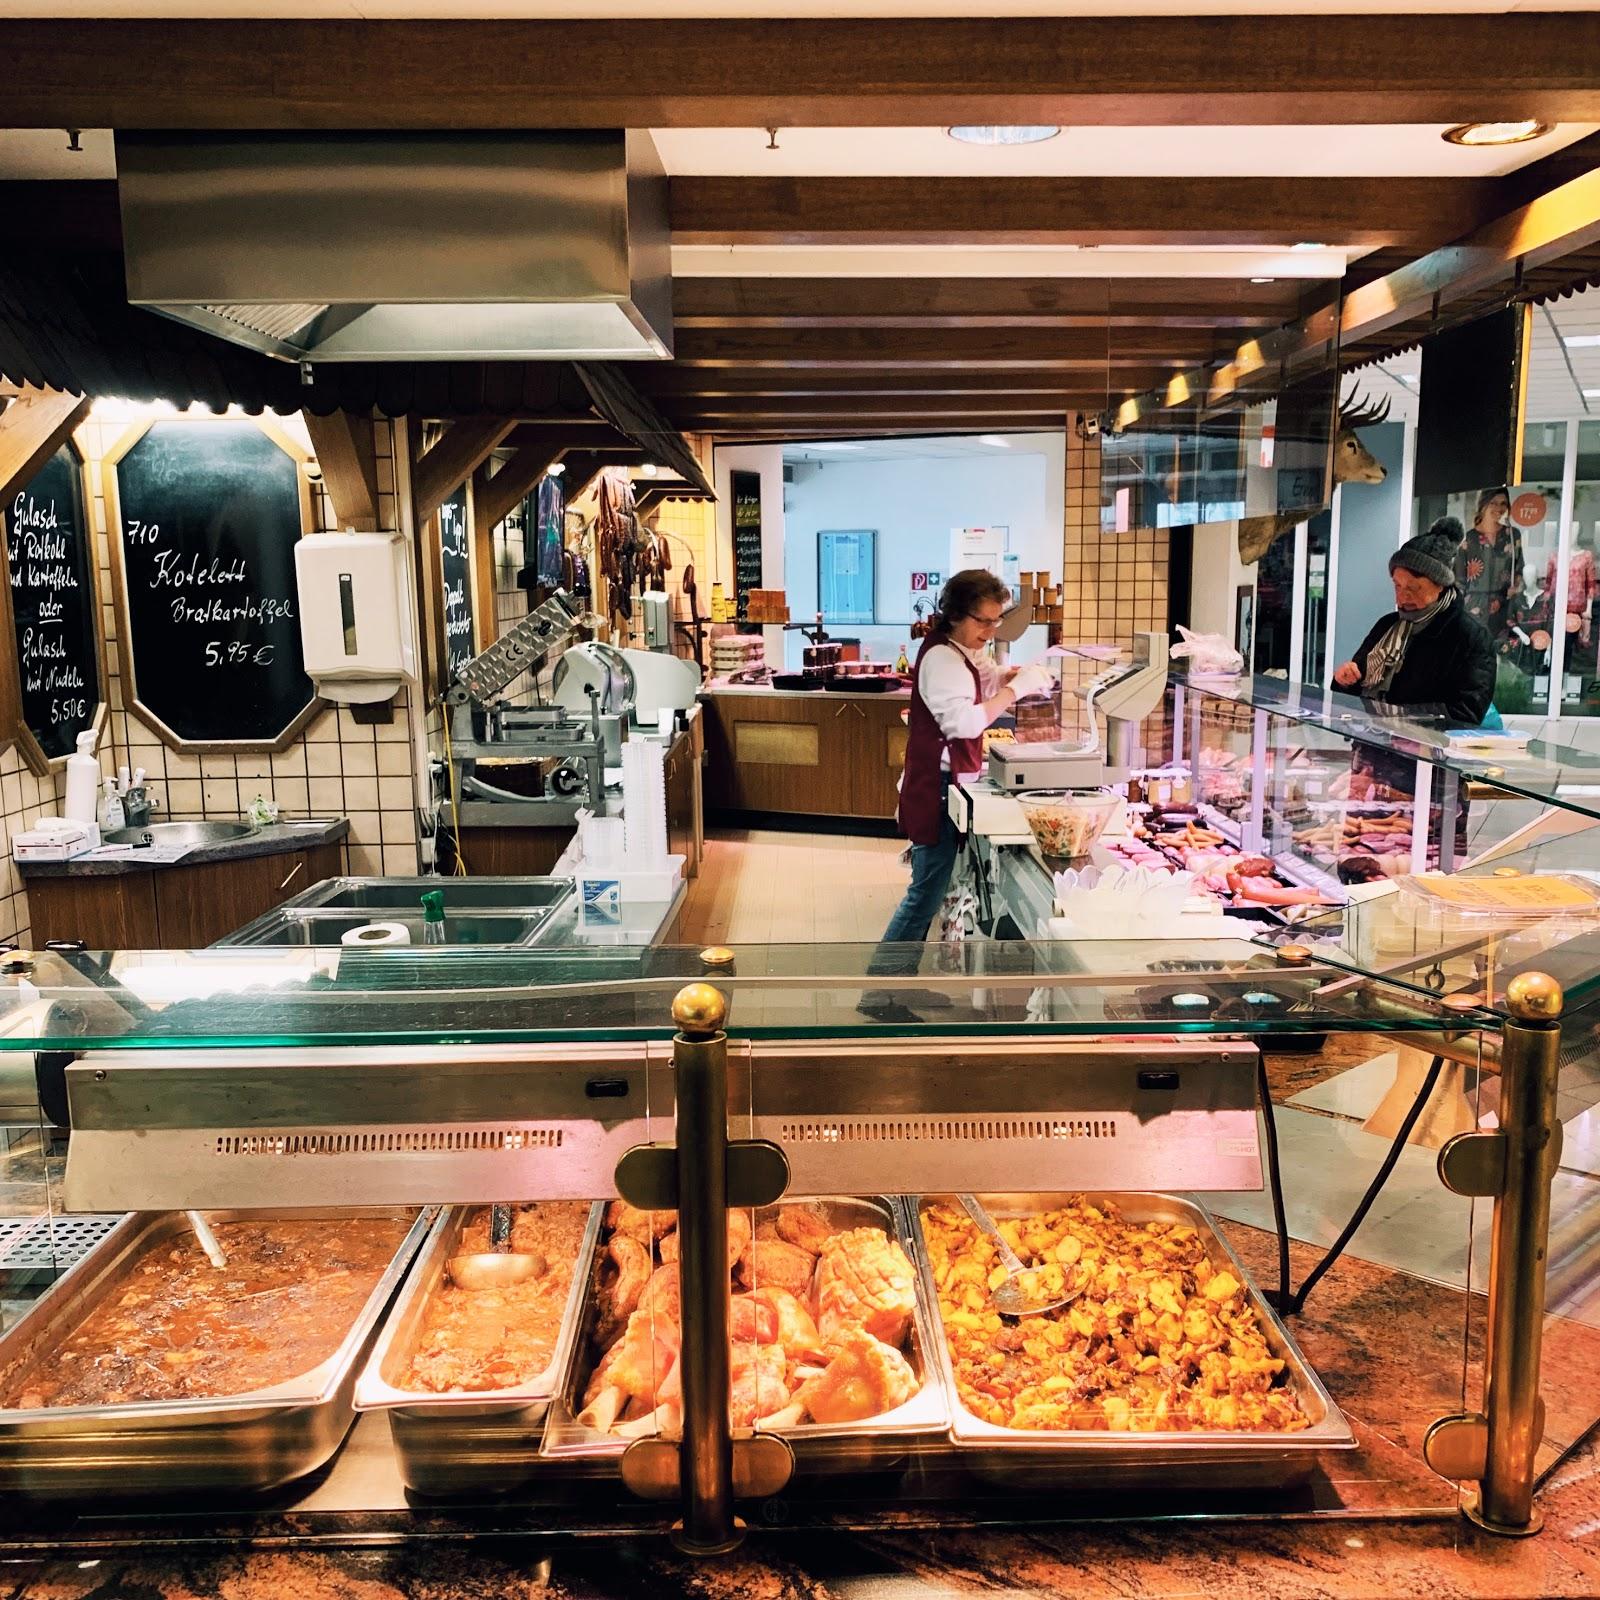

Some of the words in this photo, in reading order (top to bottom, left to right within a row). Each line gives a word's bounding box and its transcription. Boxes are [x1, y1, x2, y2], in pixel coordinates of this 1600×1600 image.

[13, 491, 58, 538] Gulasch
[24, 532, 66, 560] Rotkohl
[28, 566, 78, 592] Kartoffeln
[39, 592, 63, 617] oder
[170, 596, 294, 625] Bratkartoffel
[23, 627, 67, 668] Gulasch
[45, 665, 84, 691] Nudeln
